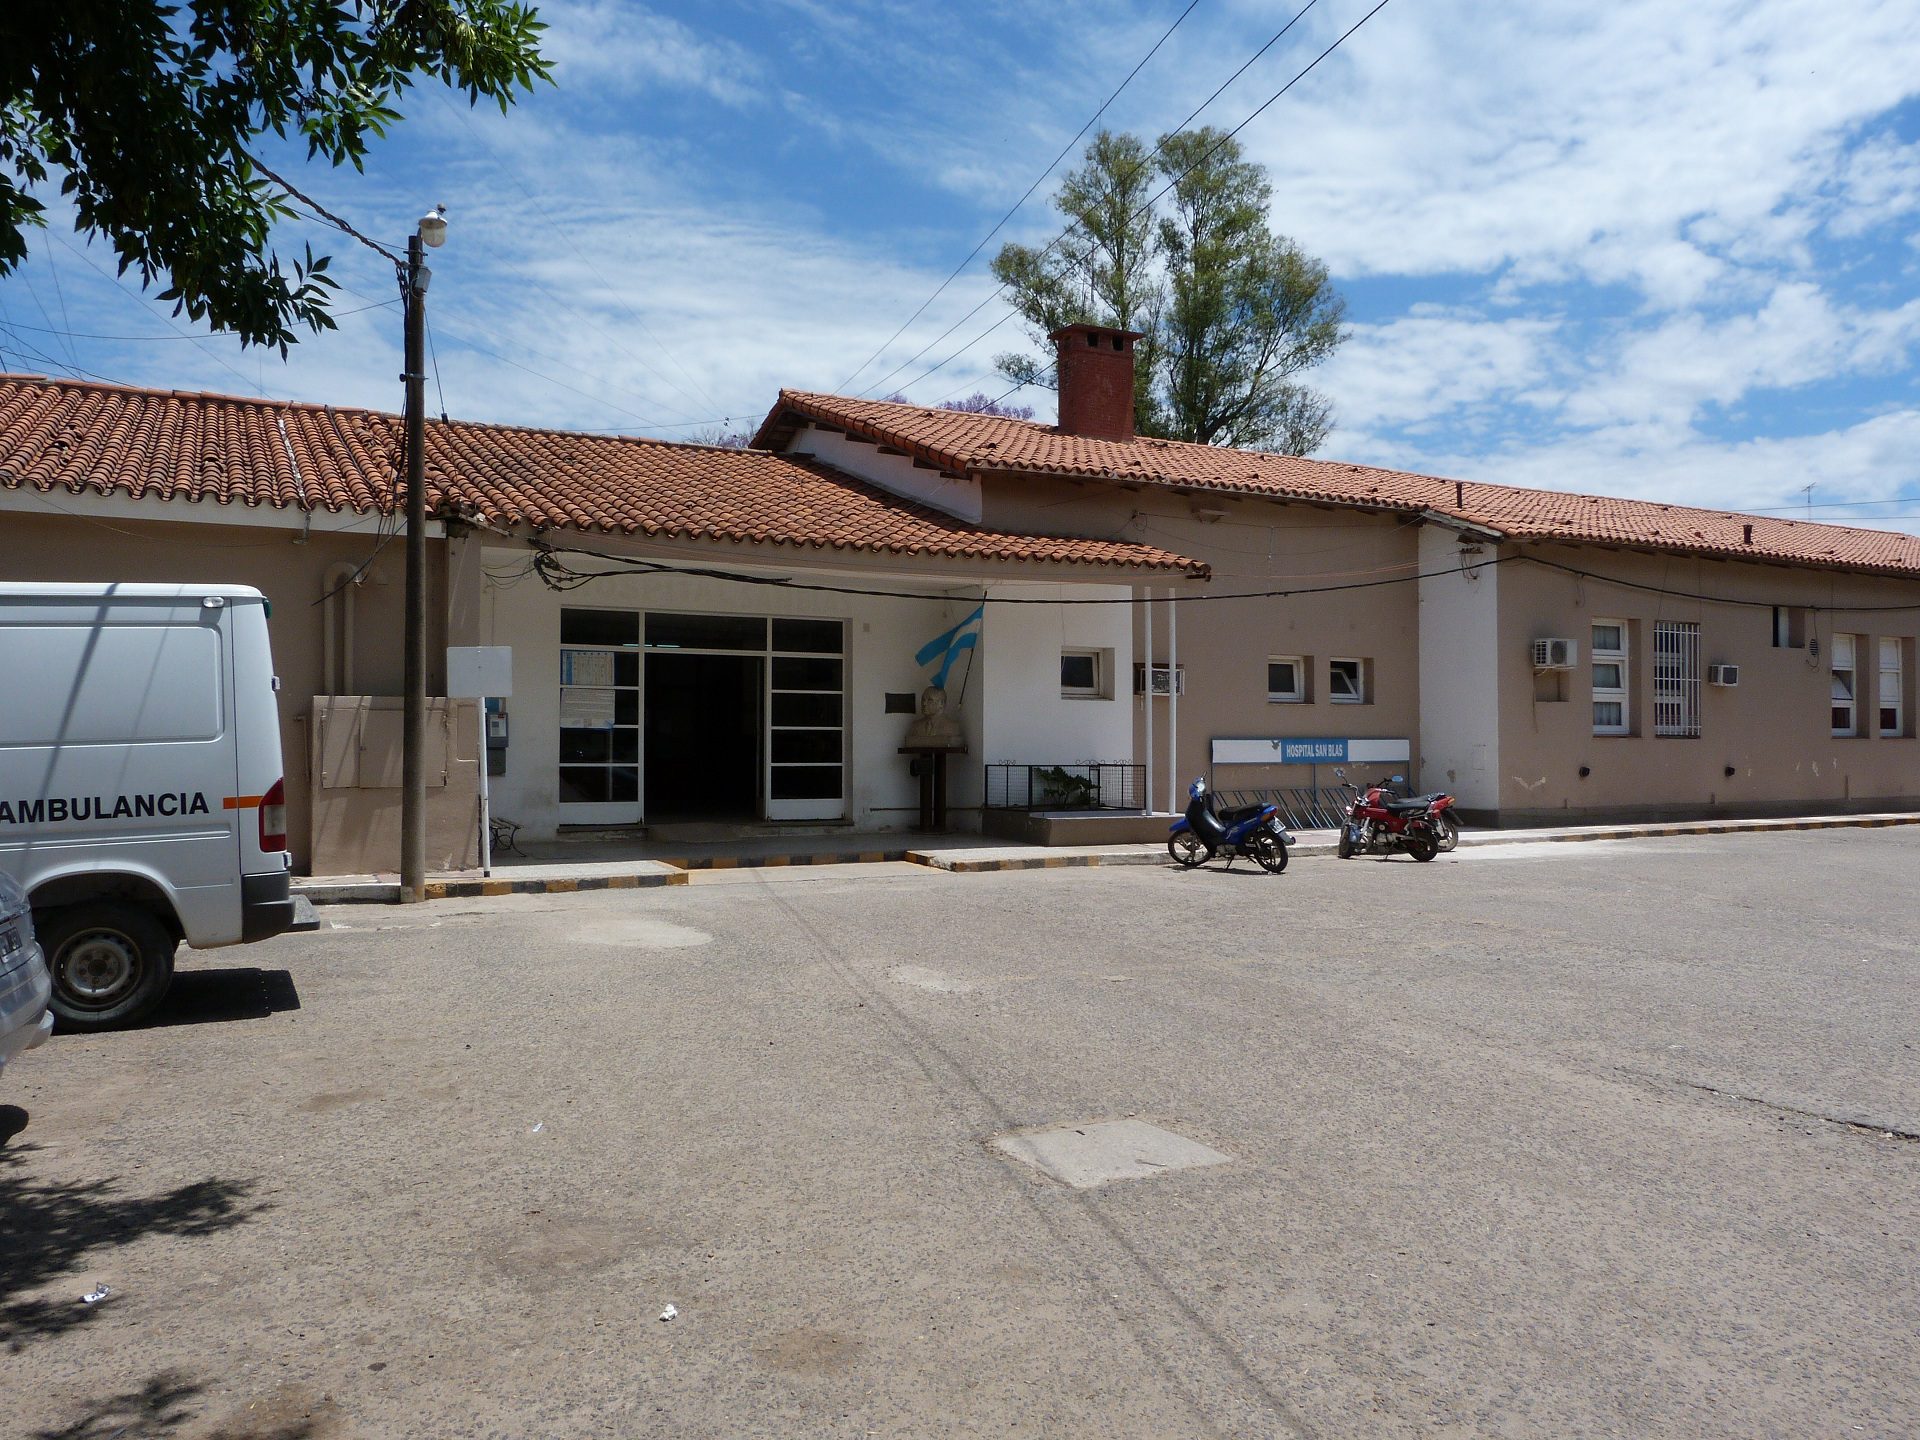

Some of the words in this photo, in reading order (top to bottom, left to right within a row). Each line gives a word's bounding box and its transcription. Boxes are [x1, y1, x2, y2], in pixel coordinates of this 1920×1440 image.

[1286, 744, 1315, 758] HOSPITAL
[1315, 744, 1328, 757] SAN
[1328, 743, 1343, 757] BLAS
[0, 792, 209, 824] AMBULANCIA
